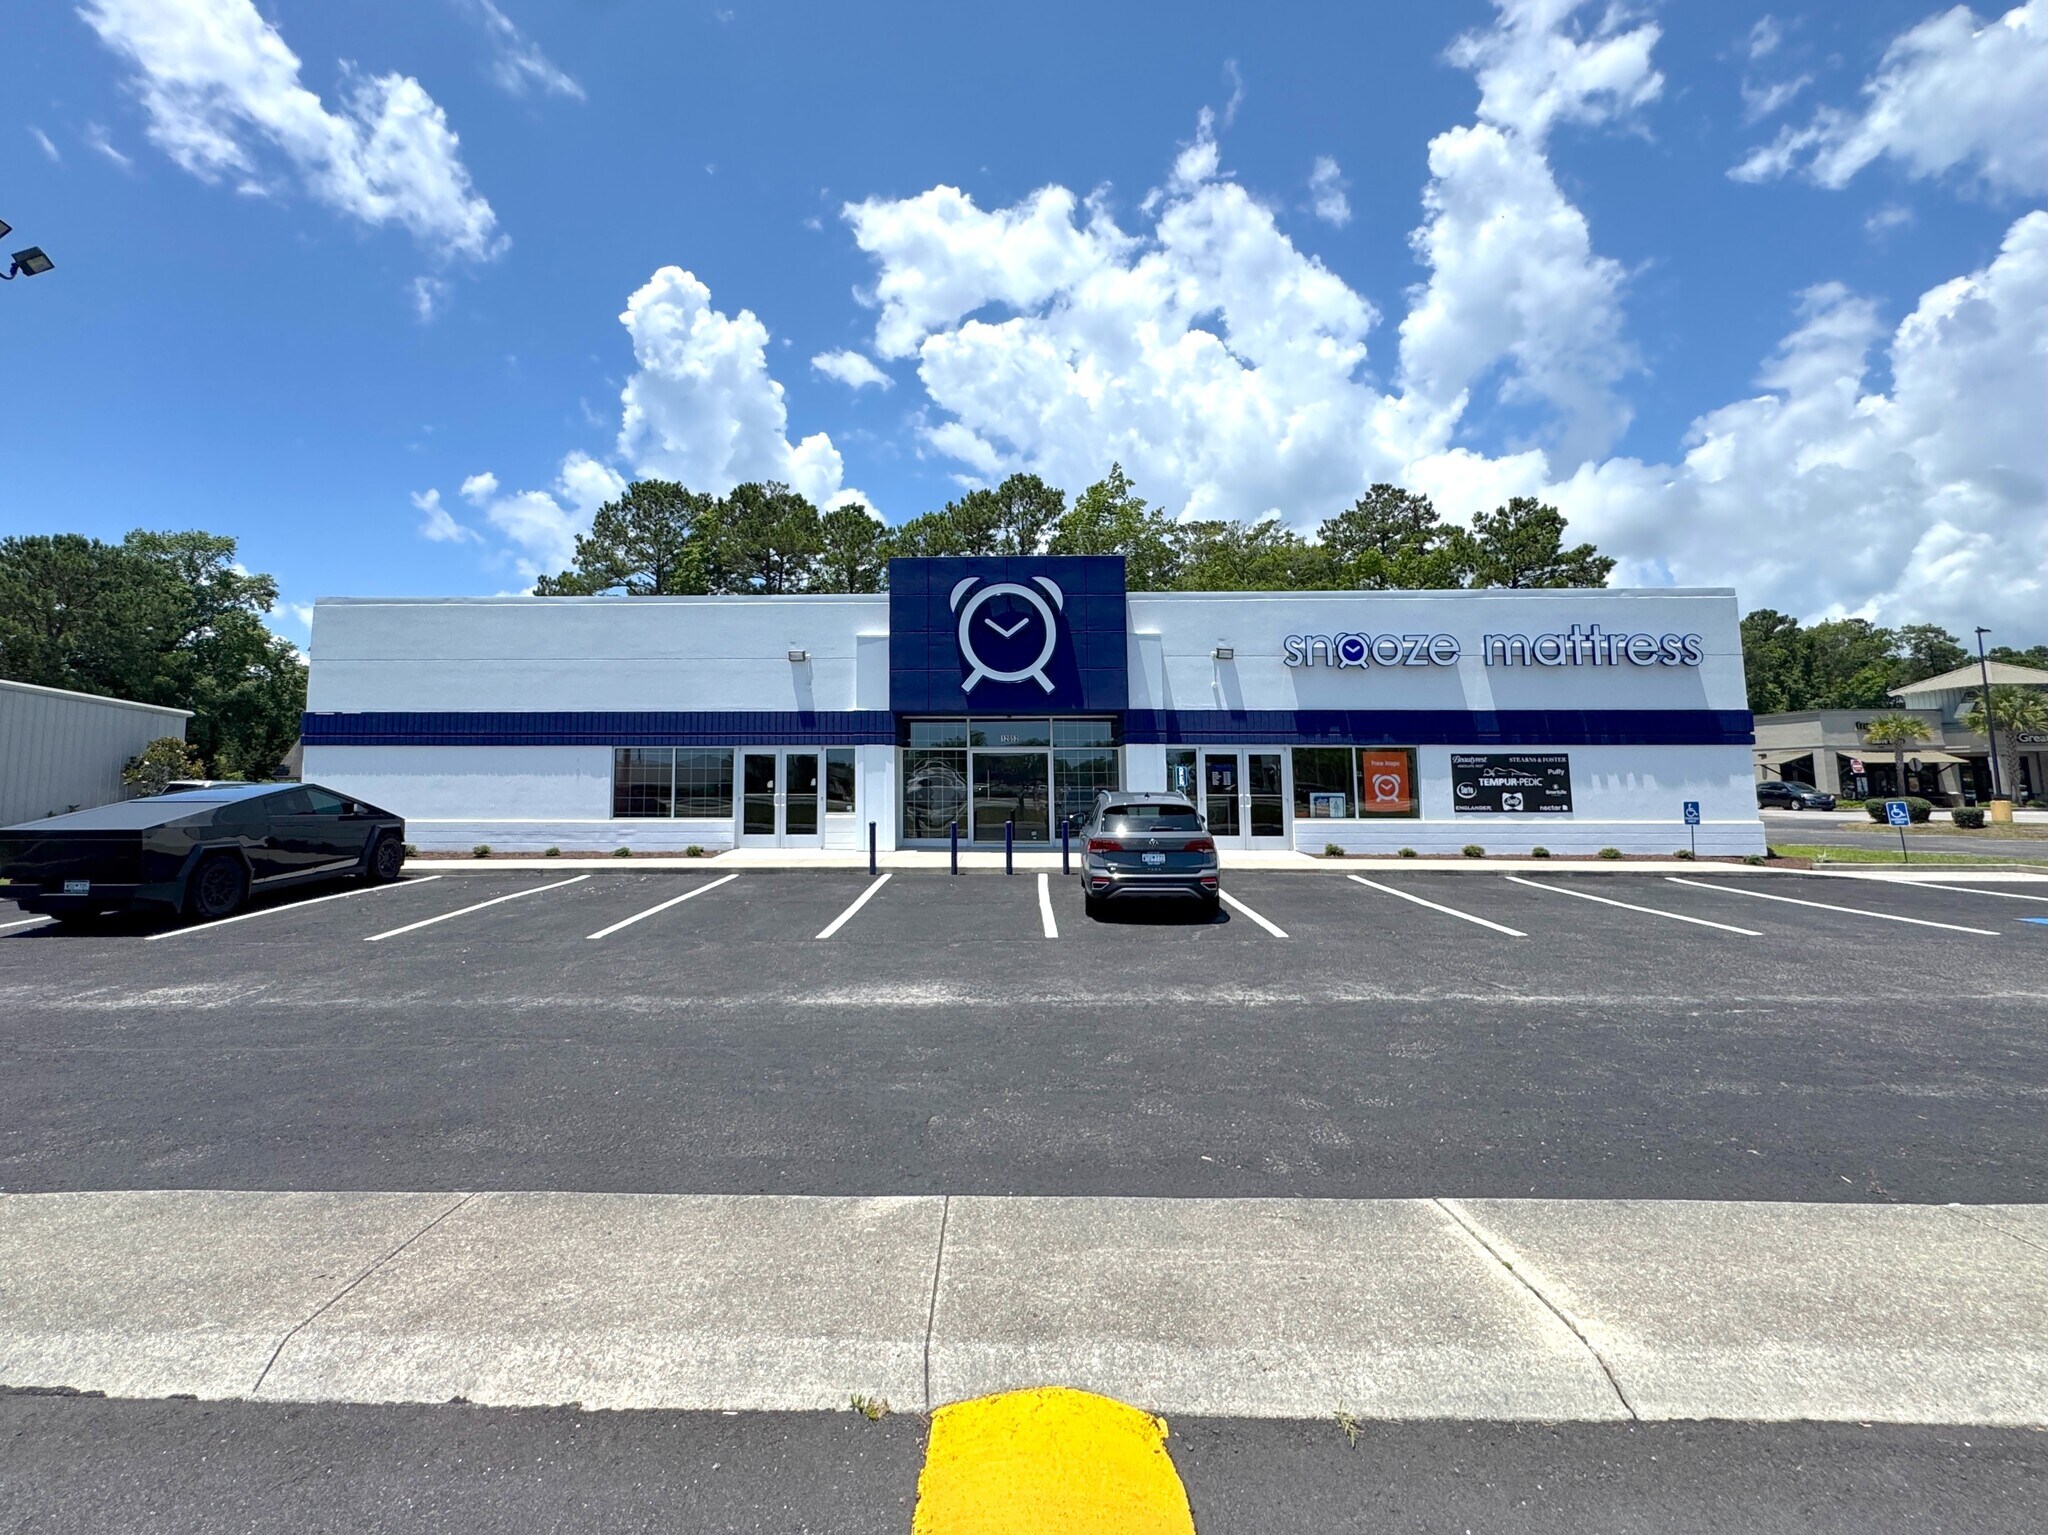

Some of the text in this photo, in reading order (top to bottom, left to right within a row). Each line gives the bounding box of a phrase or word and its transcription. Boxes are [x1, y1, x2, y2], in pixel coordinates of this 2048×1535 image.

[1482, 624, 1704, 667] mattress
[1452, 755, 1488, 764] Beautyrest
[1547, 768, 1565, 777] Puffy
[1479, 778, 1543, 787] TEMPUR-PEDIC
